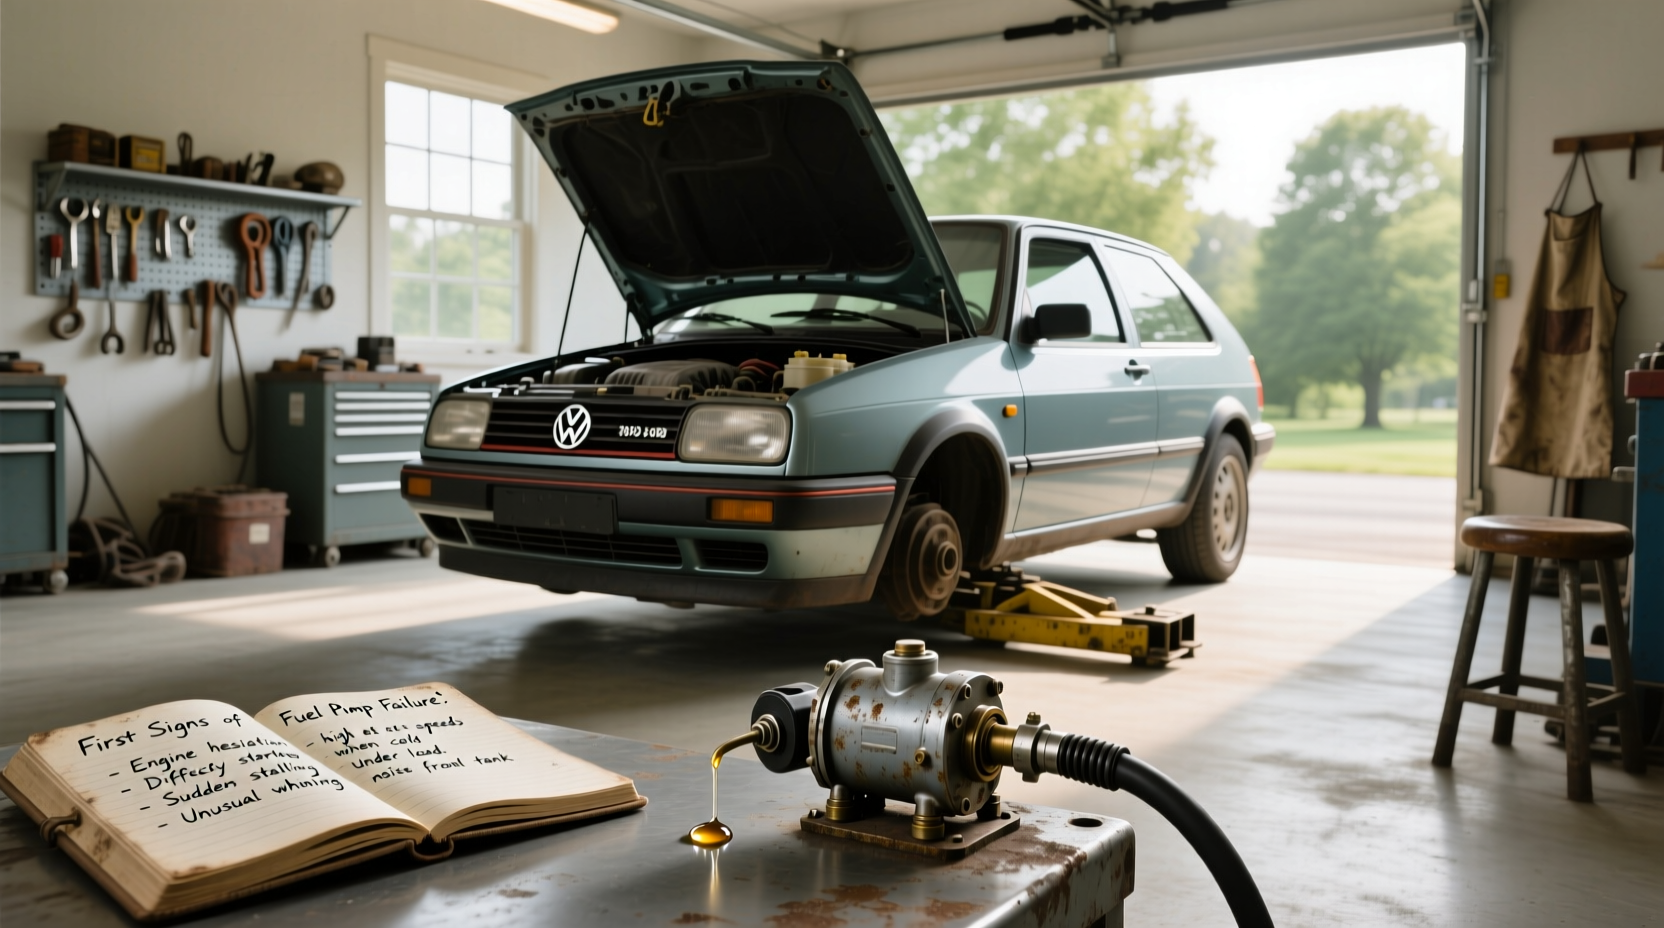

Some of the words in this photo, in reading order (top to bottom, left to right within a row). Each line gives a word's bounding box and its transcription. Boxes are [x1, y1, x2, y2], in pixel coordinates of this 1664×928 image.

[279, 706, 323, 726] Fuel
[78, 731, 136, 756] First
[148, 717, 209, 739] Signs
[223, 714, 242, 727] of
[130, 747, 197, 774] Engine
[474, 752, 514, 765] tank
[163, 780, 236, 807] Sudden
[180, 790, 262, 825] Unusual
